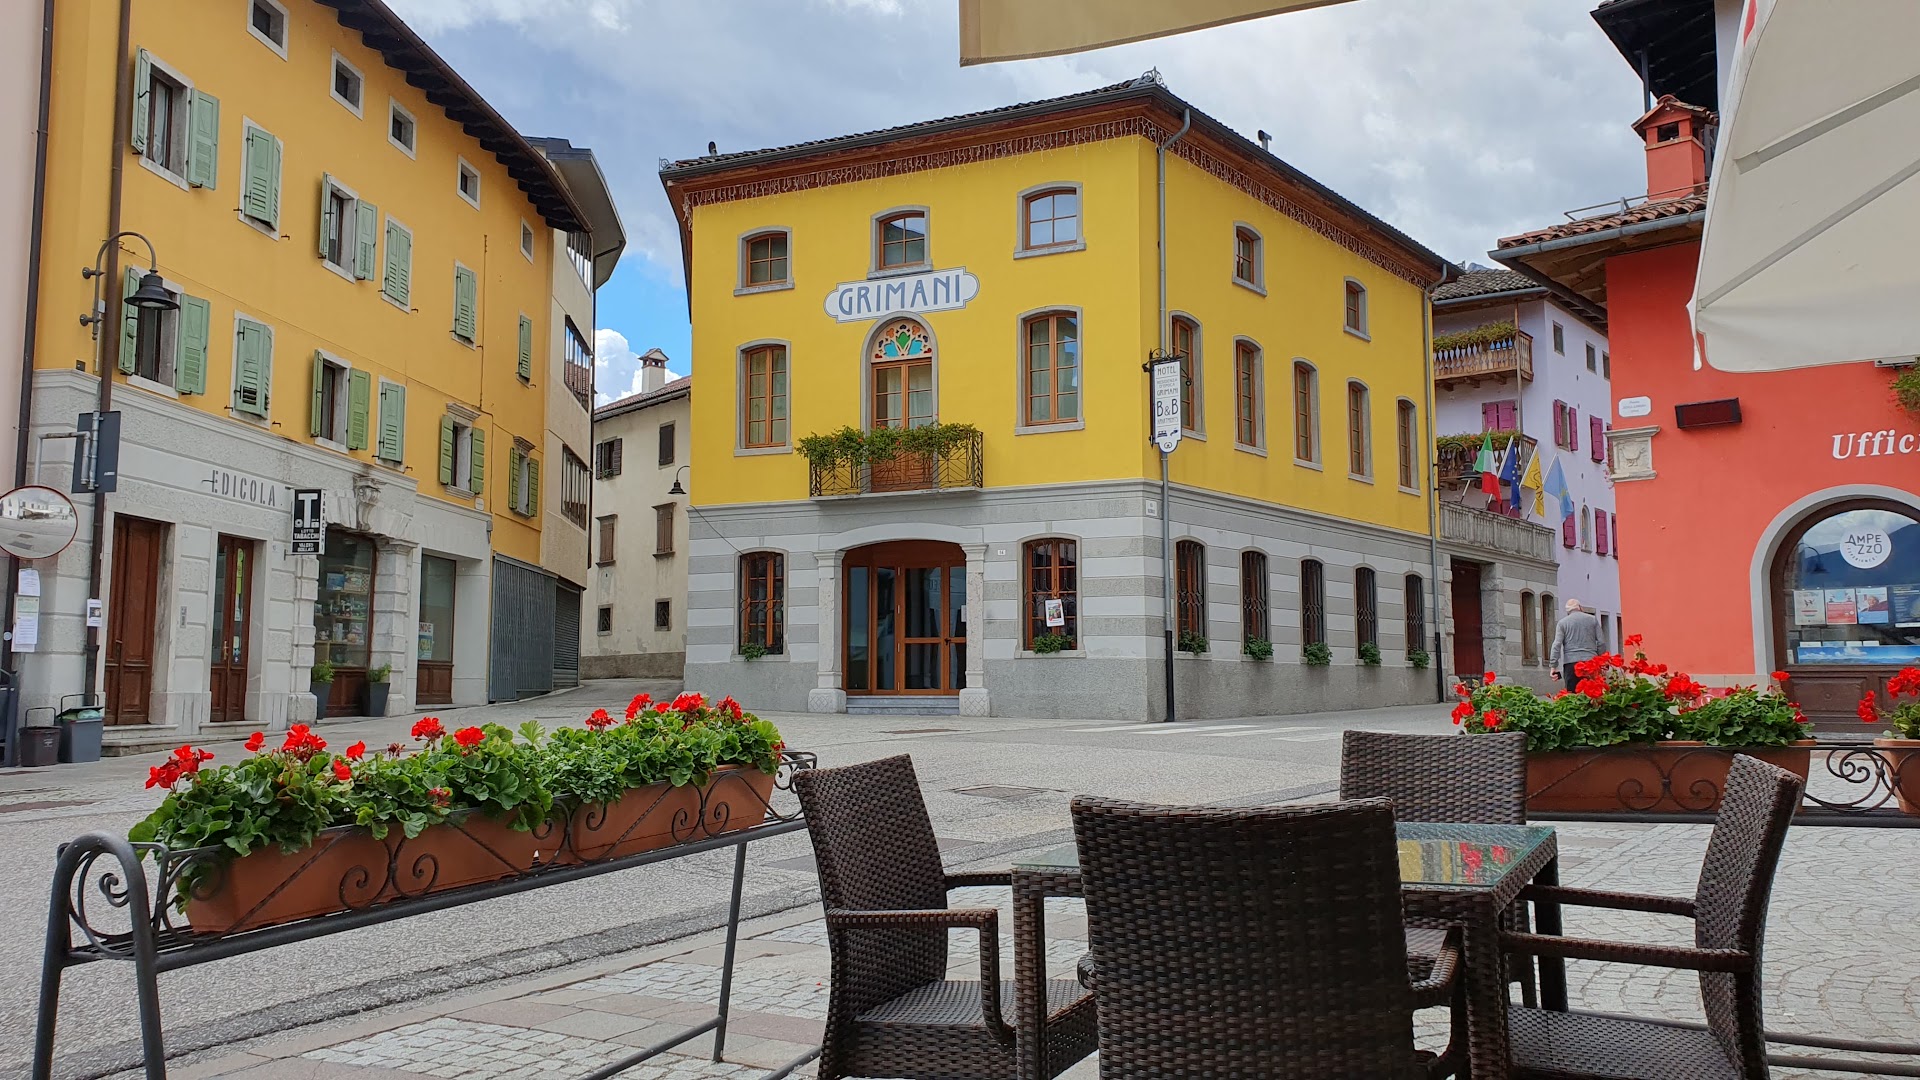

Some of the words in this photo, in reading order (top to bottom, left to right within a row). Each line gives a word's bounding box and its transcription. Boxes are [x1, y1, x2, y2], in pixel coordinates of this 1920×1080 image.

[838, 274, 960, 316] GRIMANI
[1157, 366, 1176, 376] HOTEL
[1157, 388, 1178, 396] GRIMANI
[1157, 399, 1178, 417] B&B
[211, 470, 275, 507] EDICOLA
[298, 493, 318, 528] T
